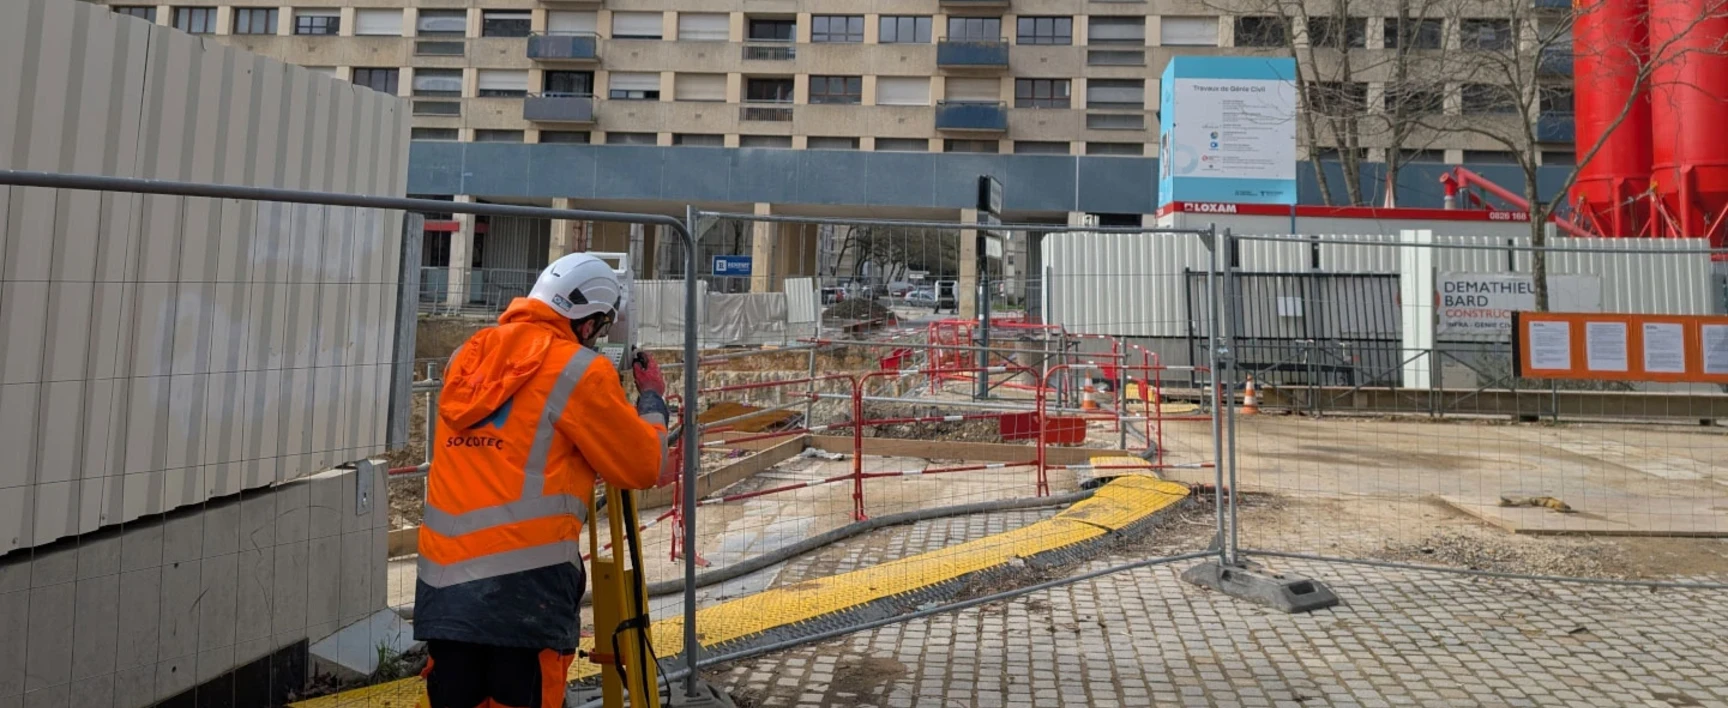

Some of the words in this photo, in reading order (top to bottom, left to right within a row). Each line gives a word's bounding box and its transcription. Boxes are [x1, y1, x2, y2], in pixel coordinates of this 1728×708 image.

[1193, 84, 1219, 92] Travaux
[1194, 203, 1237, 213] LOXAM
[1489, 211, 1510, 220] 0826
[1444, 281, 1536, 294] DEMATHIEU
[1445, 295, 1488, 307] BARD
[446, 436, 504, 450] SOCOTEC
